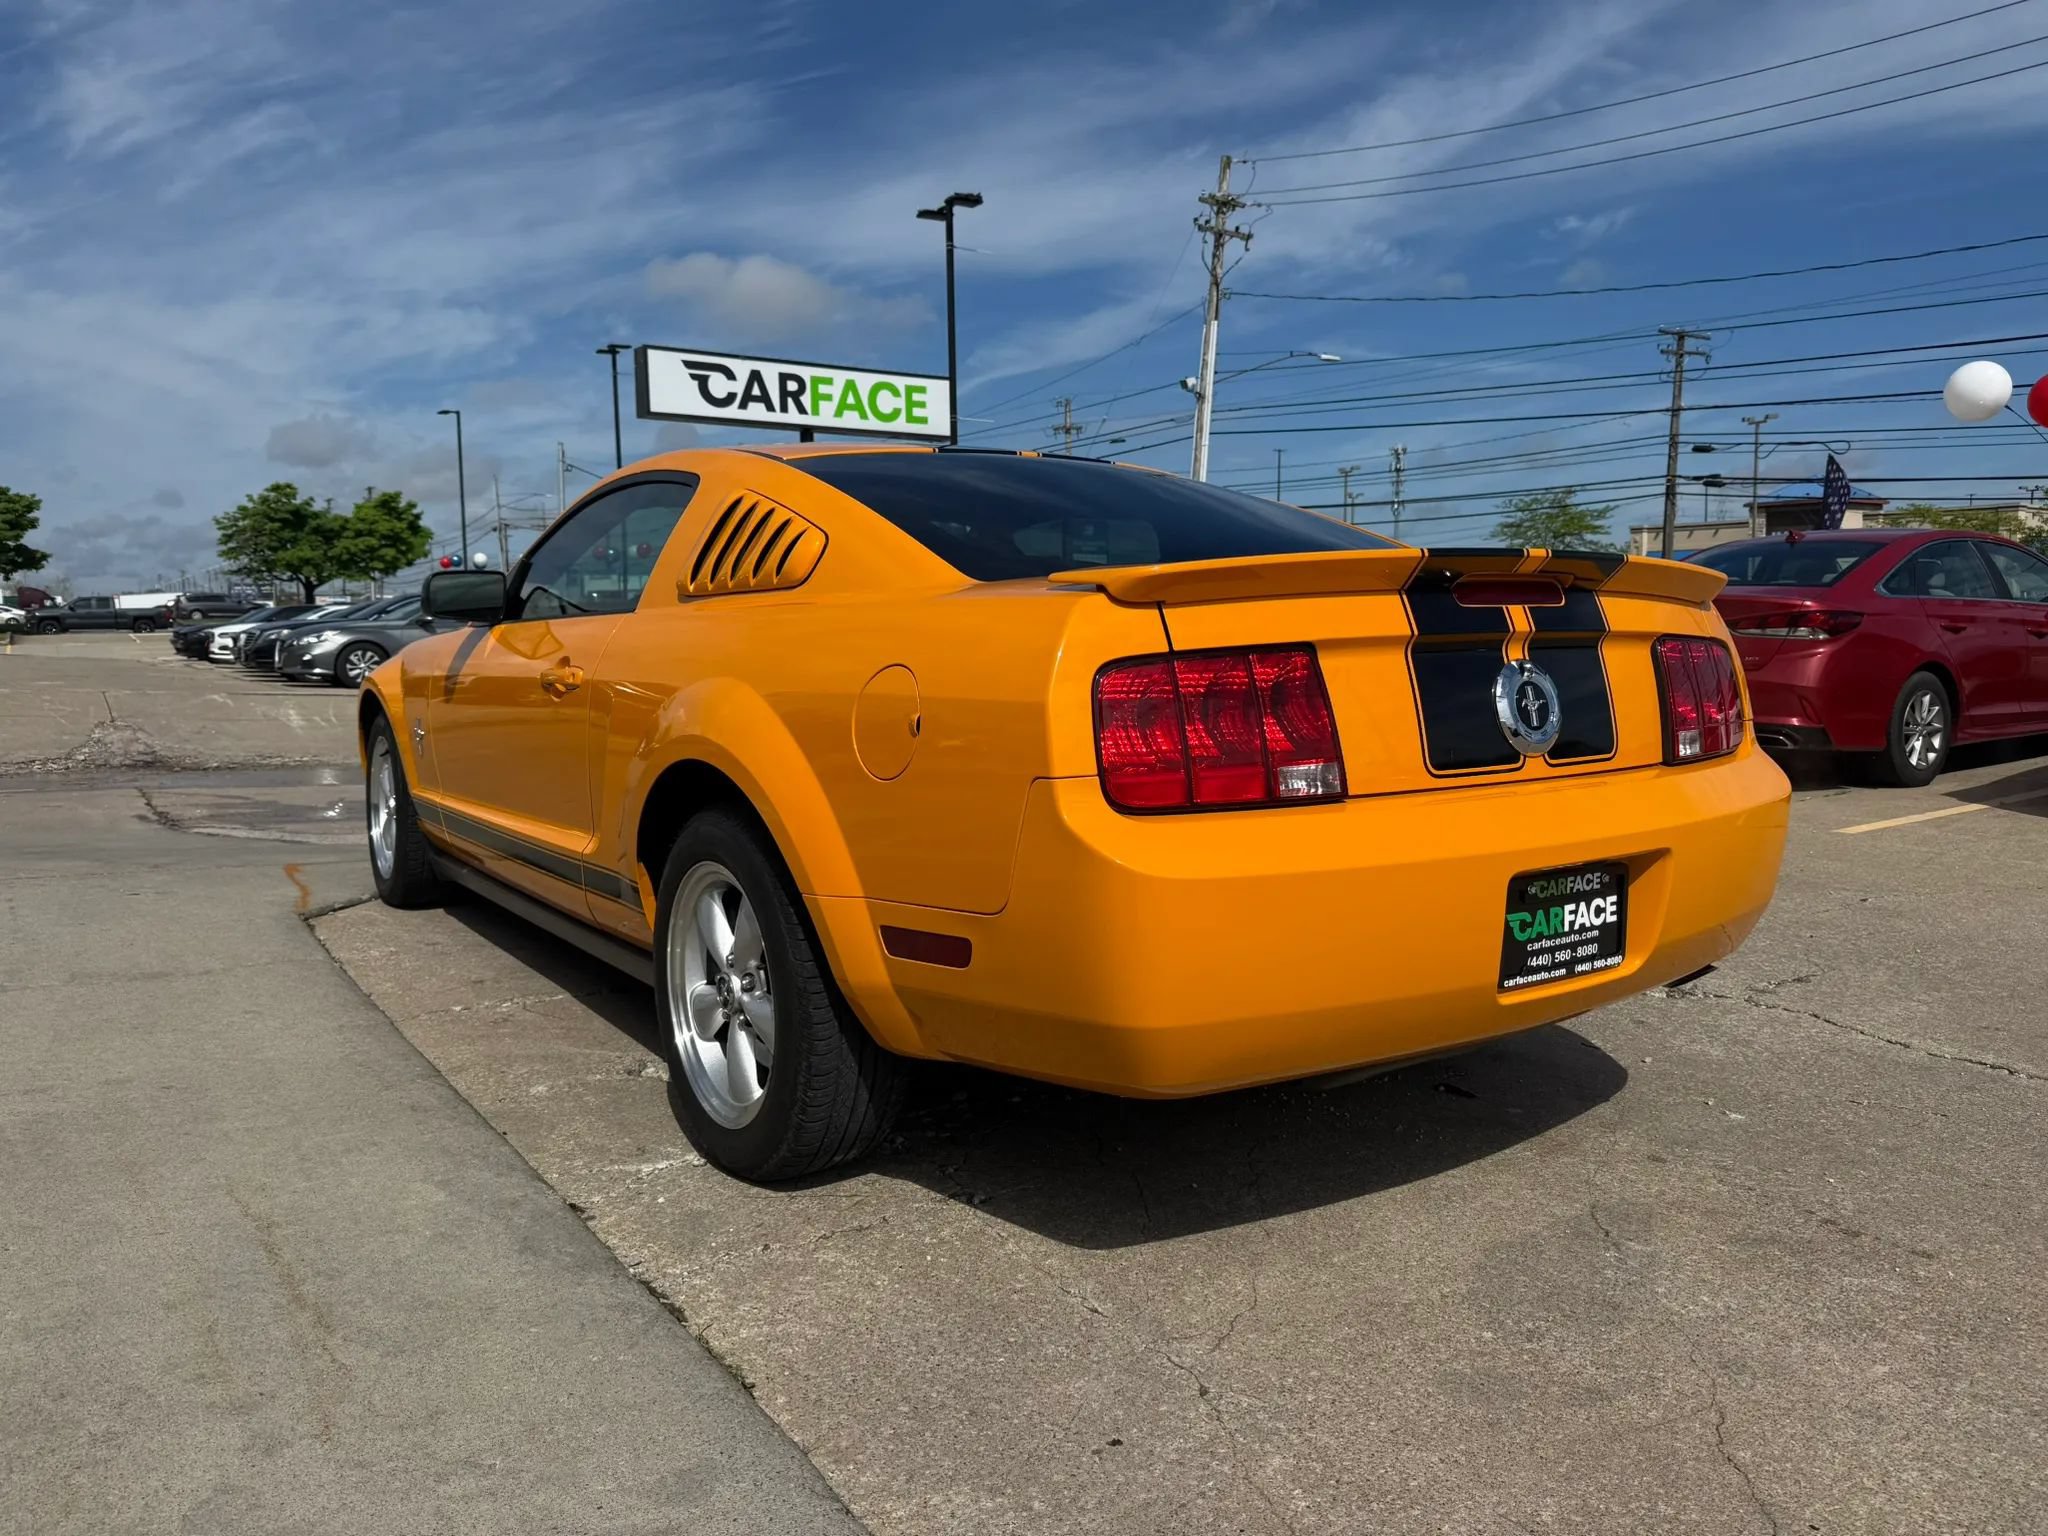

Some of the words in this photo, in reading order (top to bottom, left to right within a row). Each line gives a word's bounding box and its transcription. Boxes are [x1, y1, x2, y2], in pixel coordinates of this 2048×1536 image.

[681, 359, 929, 425] CARFACE
[1534, 872, 1602, 898] CARFACE
[1506, 895, 1618, 942] CARFACE
[1527, 929, 1599, 951] carfaceauto.com
[1503, 968, 1567, 987] carfaceauto.com
[1574, 961, 1592, 975] (440)
[1593, 955, 1623, 969] 560-8080
[1527, 953, 1552, 967] (440)
